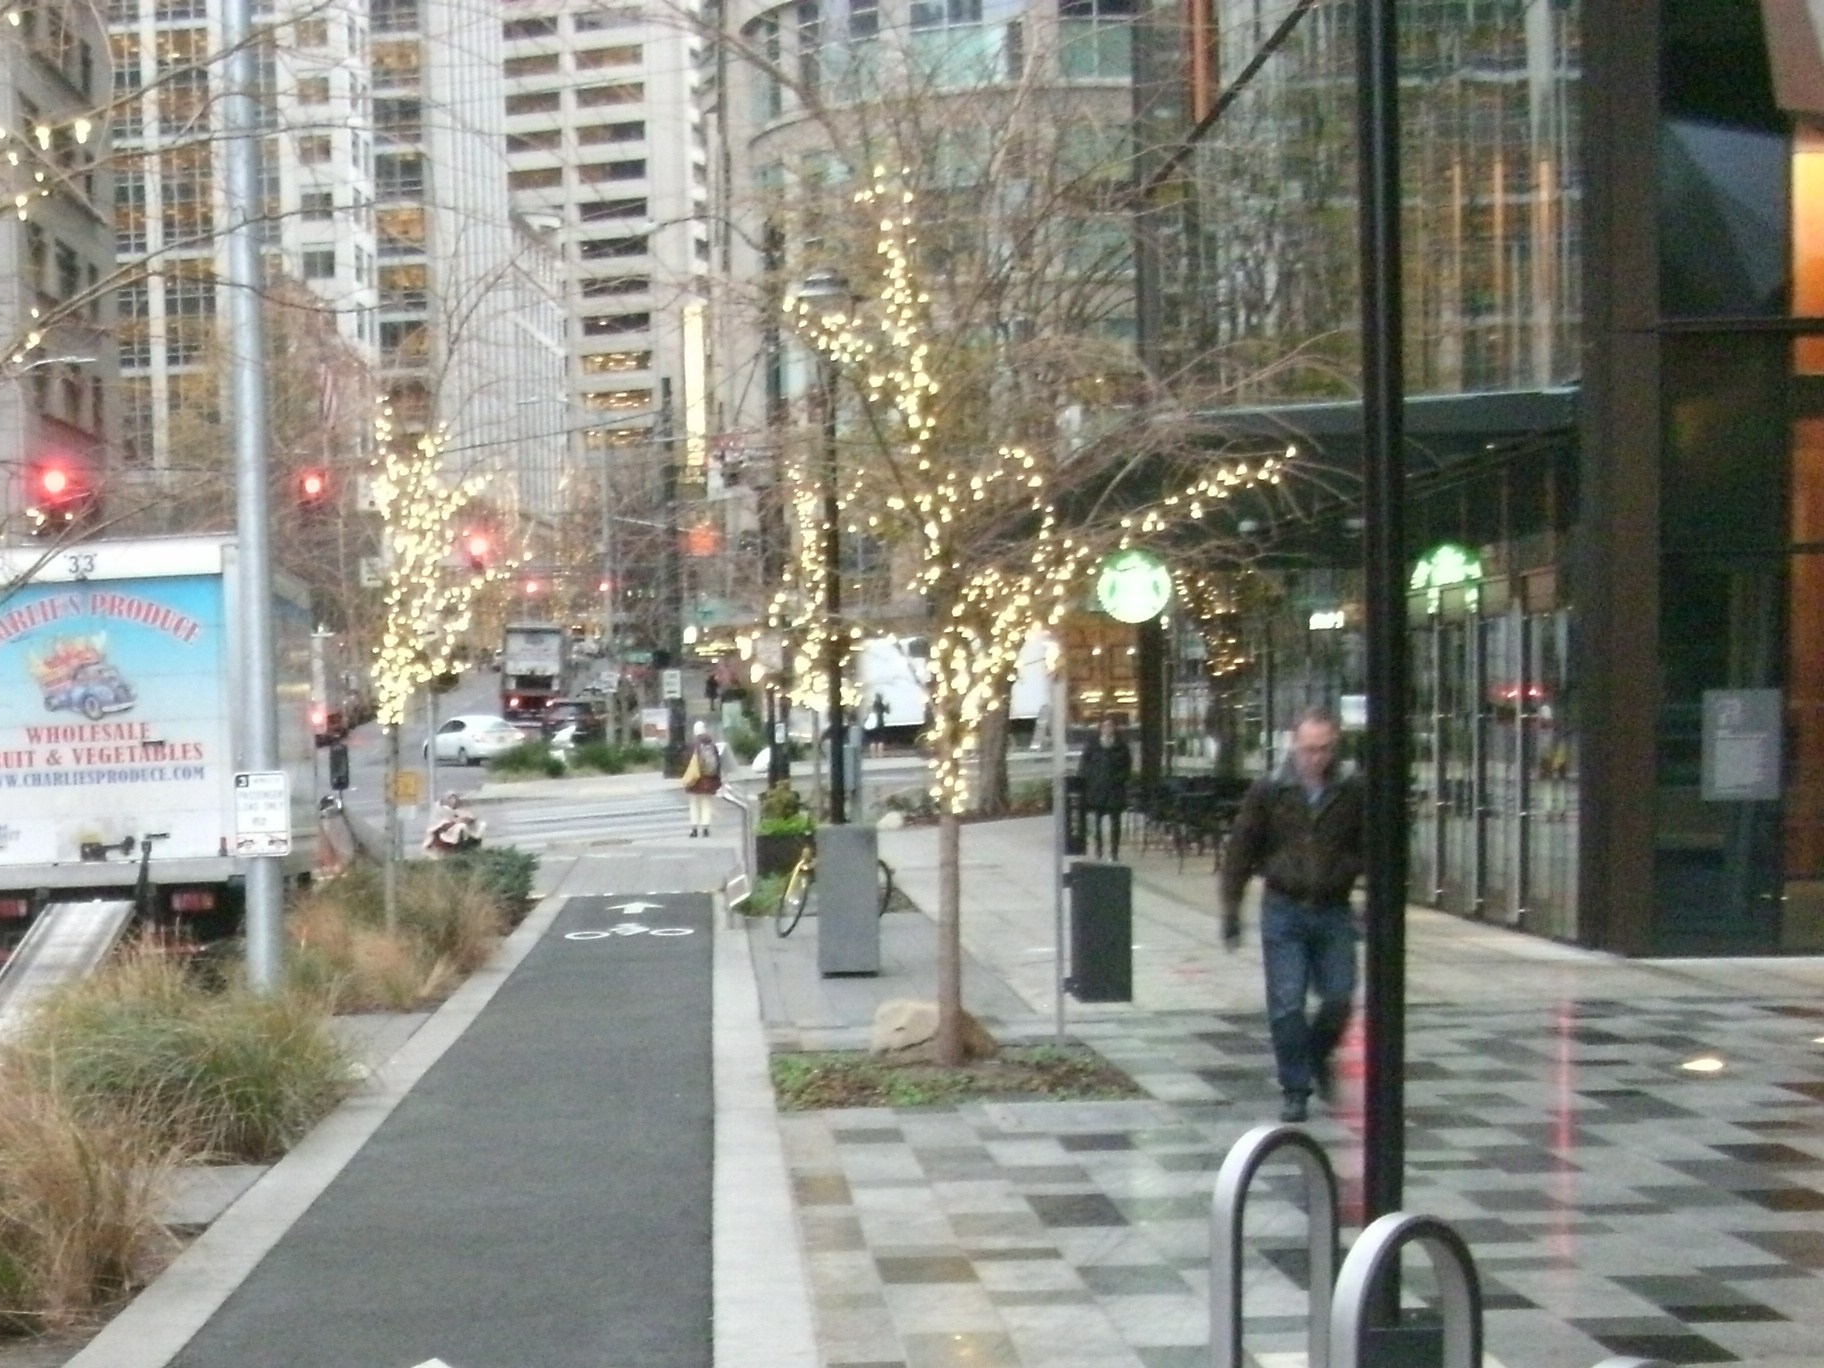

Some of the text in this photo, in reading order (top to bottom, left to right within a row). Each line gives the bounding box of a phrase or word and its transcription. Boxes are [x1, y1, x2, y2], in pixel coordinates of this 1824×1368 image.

[68, 554, 94, 573] 33
[90, 593, 200, 646] PRODUCE
[26, 722, 151, 745] WHOLESALE
[46, 748, 63, 766] &
[73, 742, 204, 765] VEGETABLES
